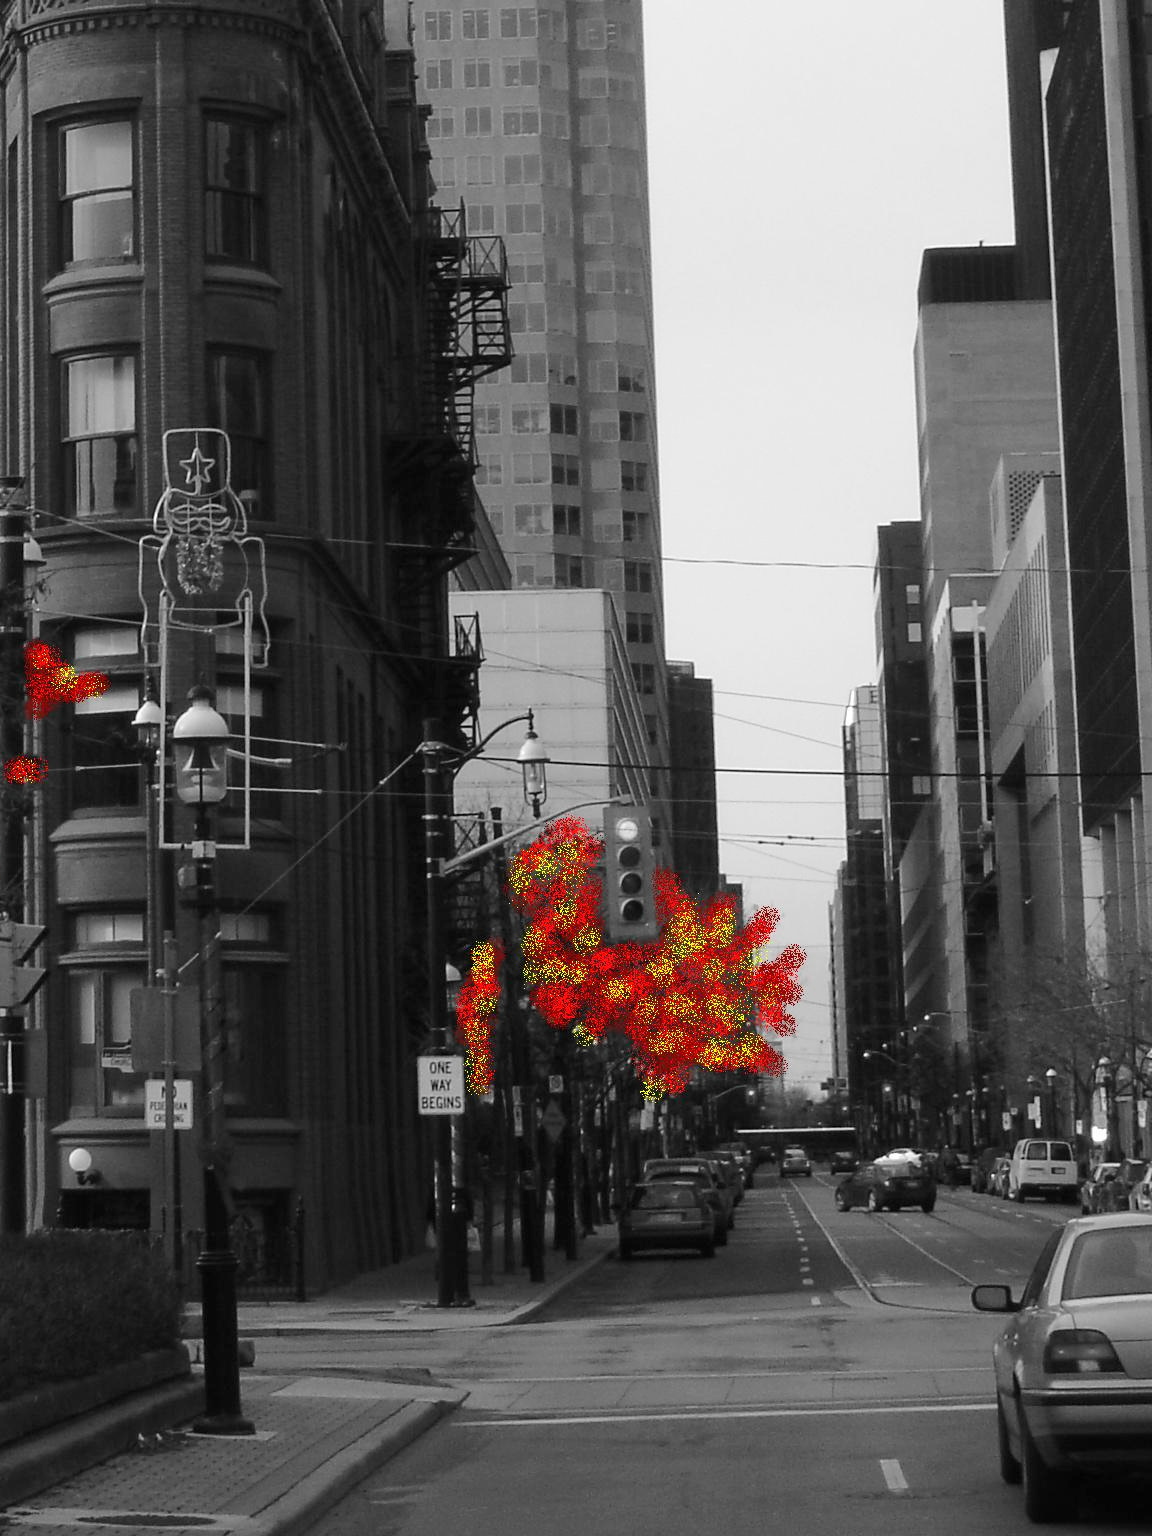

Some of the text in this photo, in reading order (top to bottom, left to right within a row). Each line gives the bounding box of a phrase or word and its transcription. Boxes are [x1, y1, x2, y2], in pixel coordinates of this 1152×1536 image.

[429, 1061, 452, 1074] ONE
[430, 1079, 452, 1092] WAY
[421, 1096, 462, 1110] BEGINS
